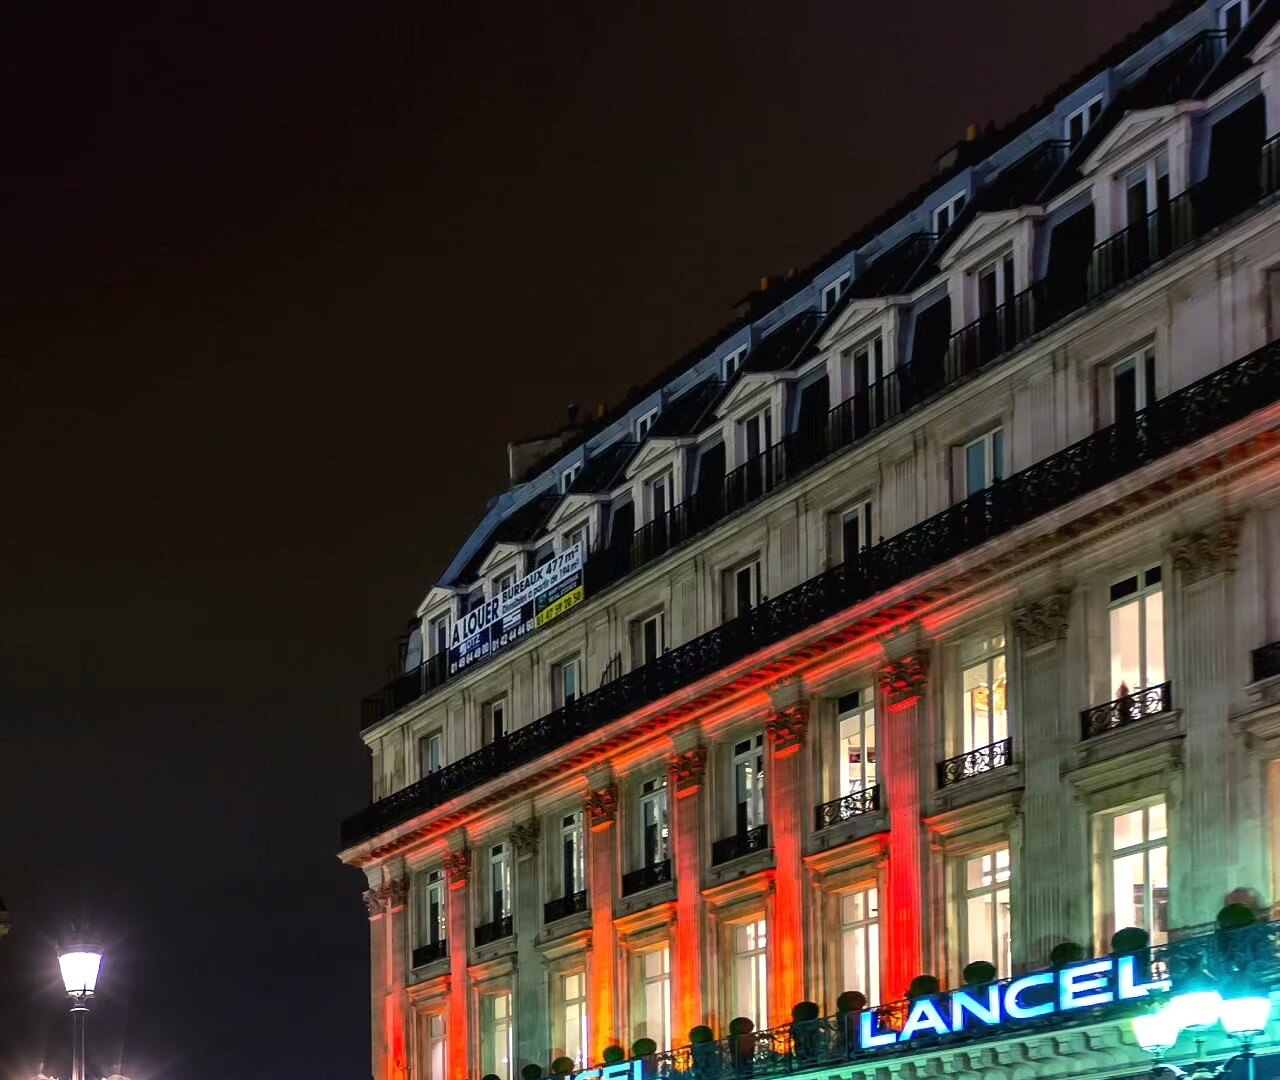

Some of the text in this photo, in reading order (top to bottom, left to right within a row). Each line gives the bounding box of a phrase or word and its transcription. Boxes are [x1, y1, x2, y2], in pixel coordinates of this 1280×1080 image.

[502, 567, 544, 603] BUREAUX
[546, 553, 564, 575] 477
[462, 598, 499, 639] LOUER
[861, 955, 1172, 1049] LANCEL
